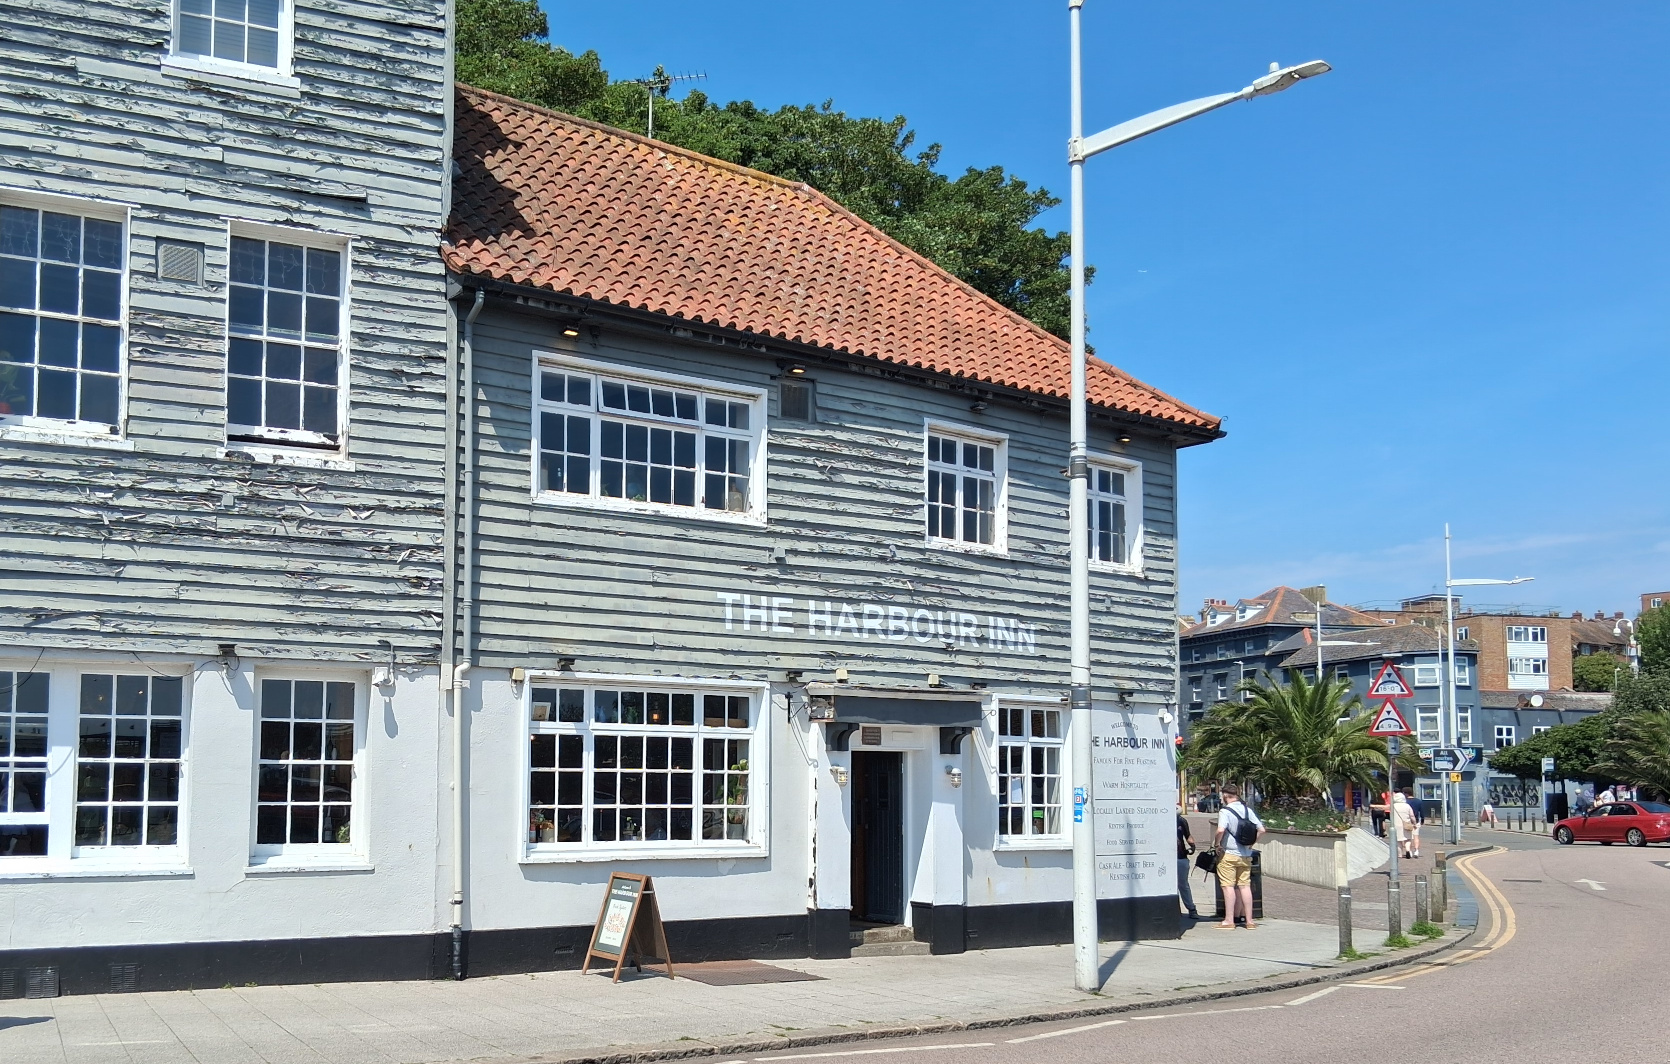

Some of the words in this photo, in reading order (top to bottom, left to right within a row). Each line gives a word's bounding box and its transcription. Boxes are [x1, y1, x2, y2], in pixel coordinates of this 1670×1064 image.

[717, 592, 795, 633] THE
[808, 600, 980, 648] HARBOUR
[988, 616, 1036, 654] INN
[1103, 736, 1148, 749] HARBOUR
[1151, 738, 1165, 750] INN
[1102, 780, 1119, 788] WARM
[1120, 781, 1149, 789] HOSPITALITY
